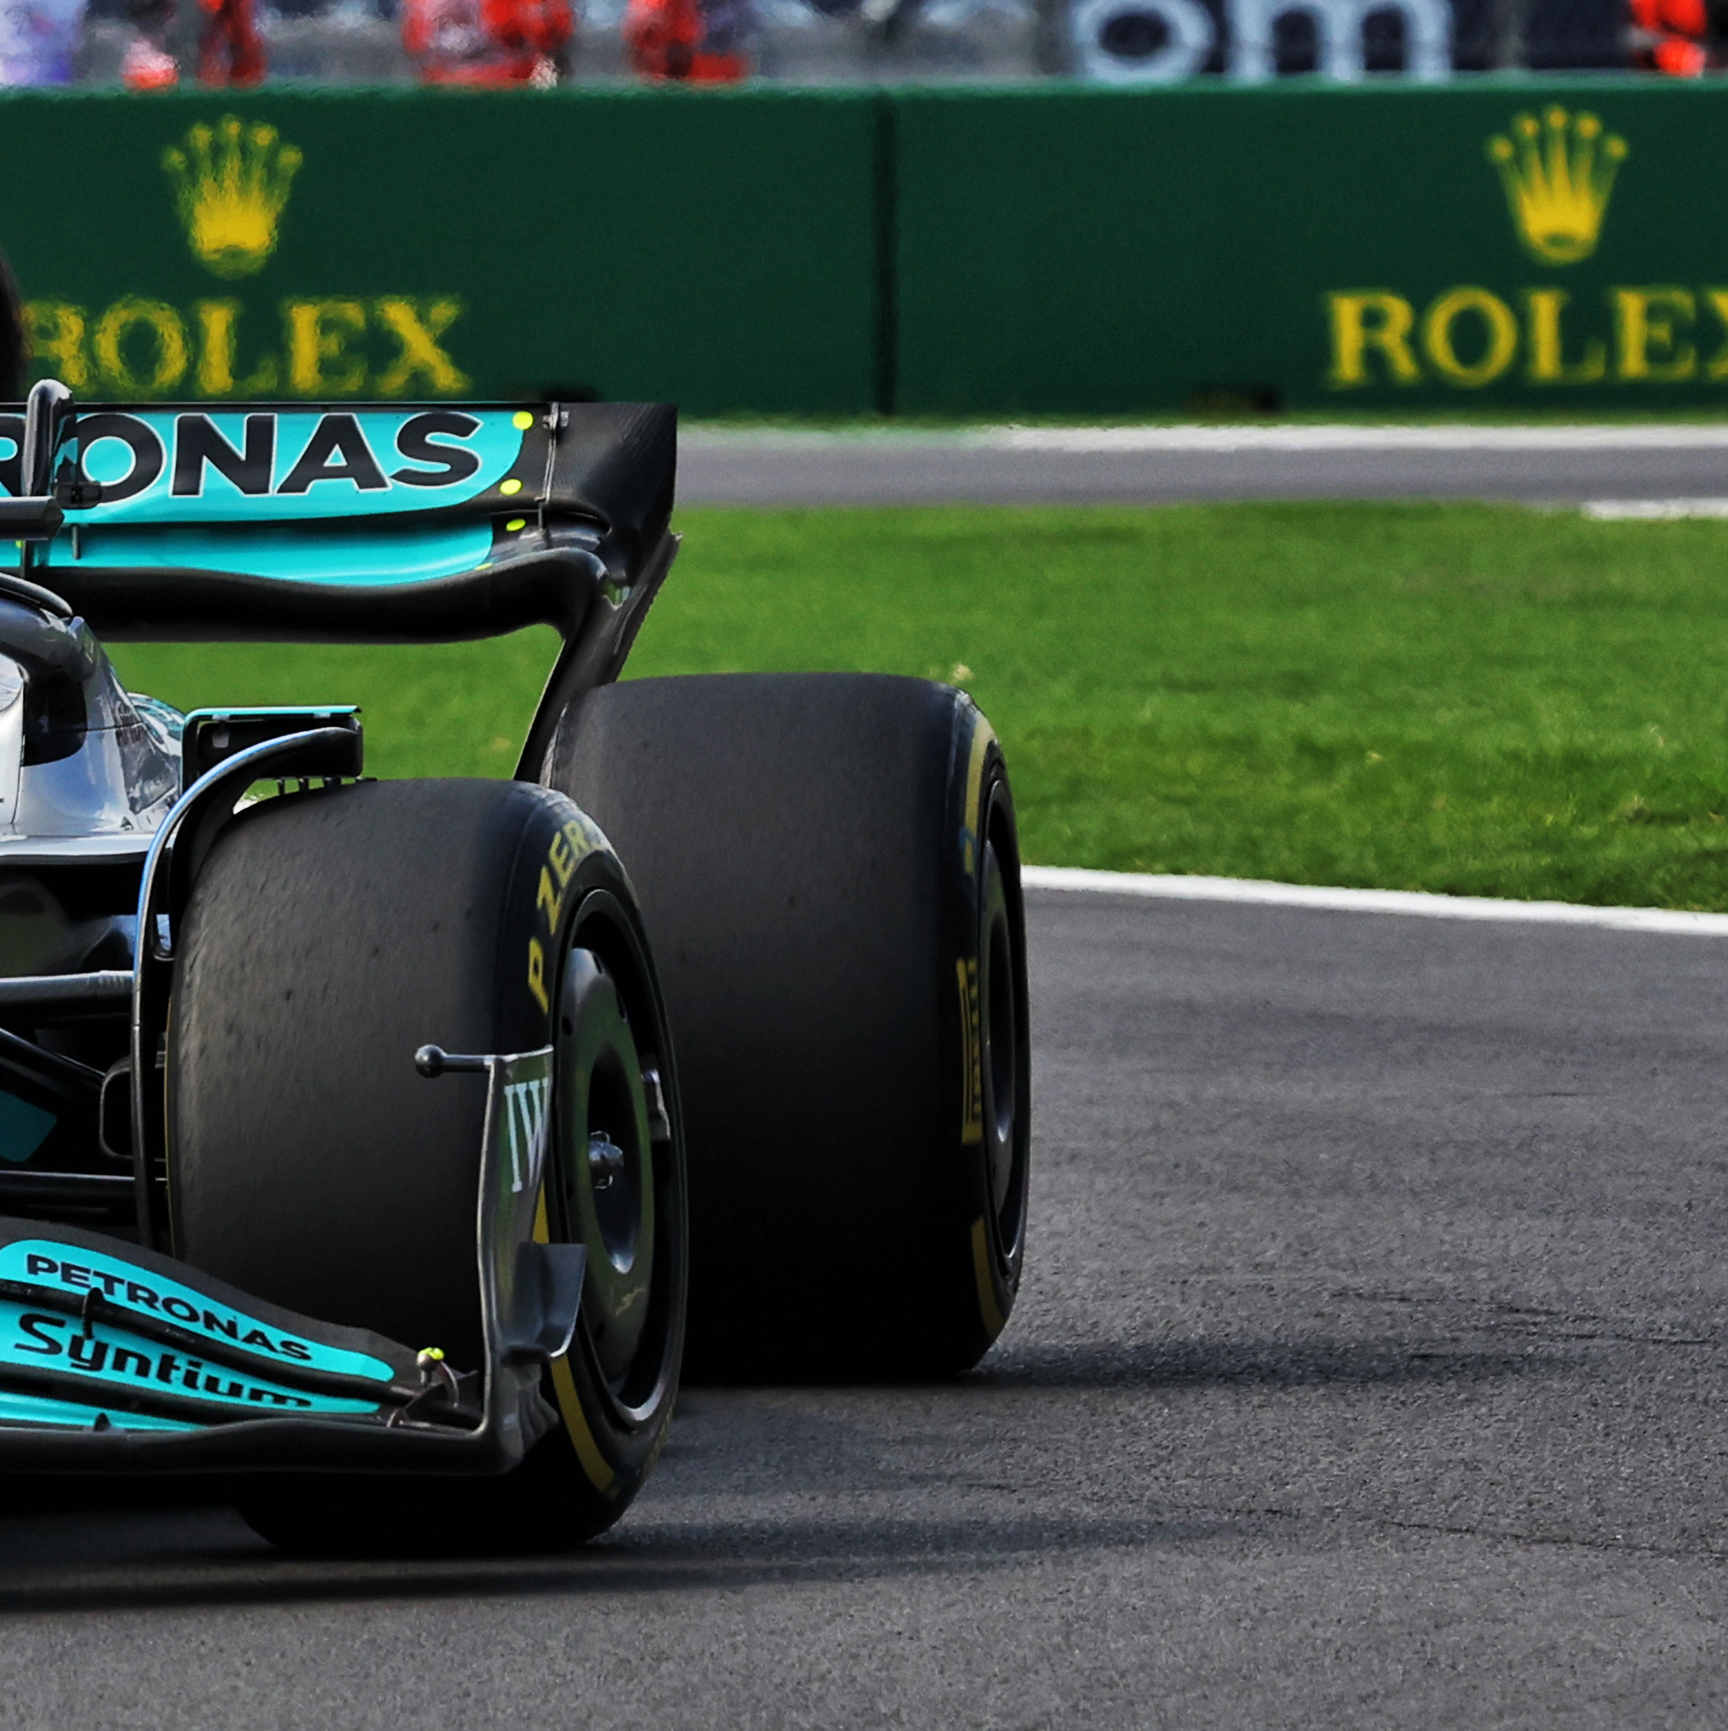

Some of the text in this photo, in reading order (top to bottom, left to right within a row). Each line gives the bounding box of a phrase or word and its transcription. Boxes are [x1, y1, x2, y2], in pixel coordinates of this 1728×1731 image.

[21, 294, 473, 399] ROLEX
[1323, 284, 1728, 388] ROLE
[26, 1252, 313, 1362] PETRONAS
[13, 1312, 312, 1408] Syntium
